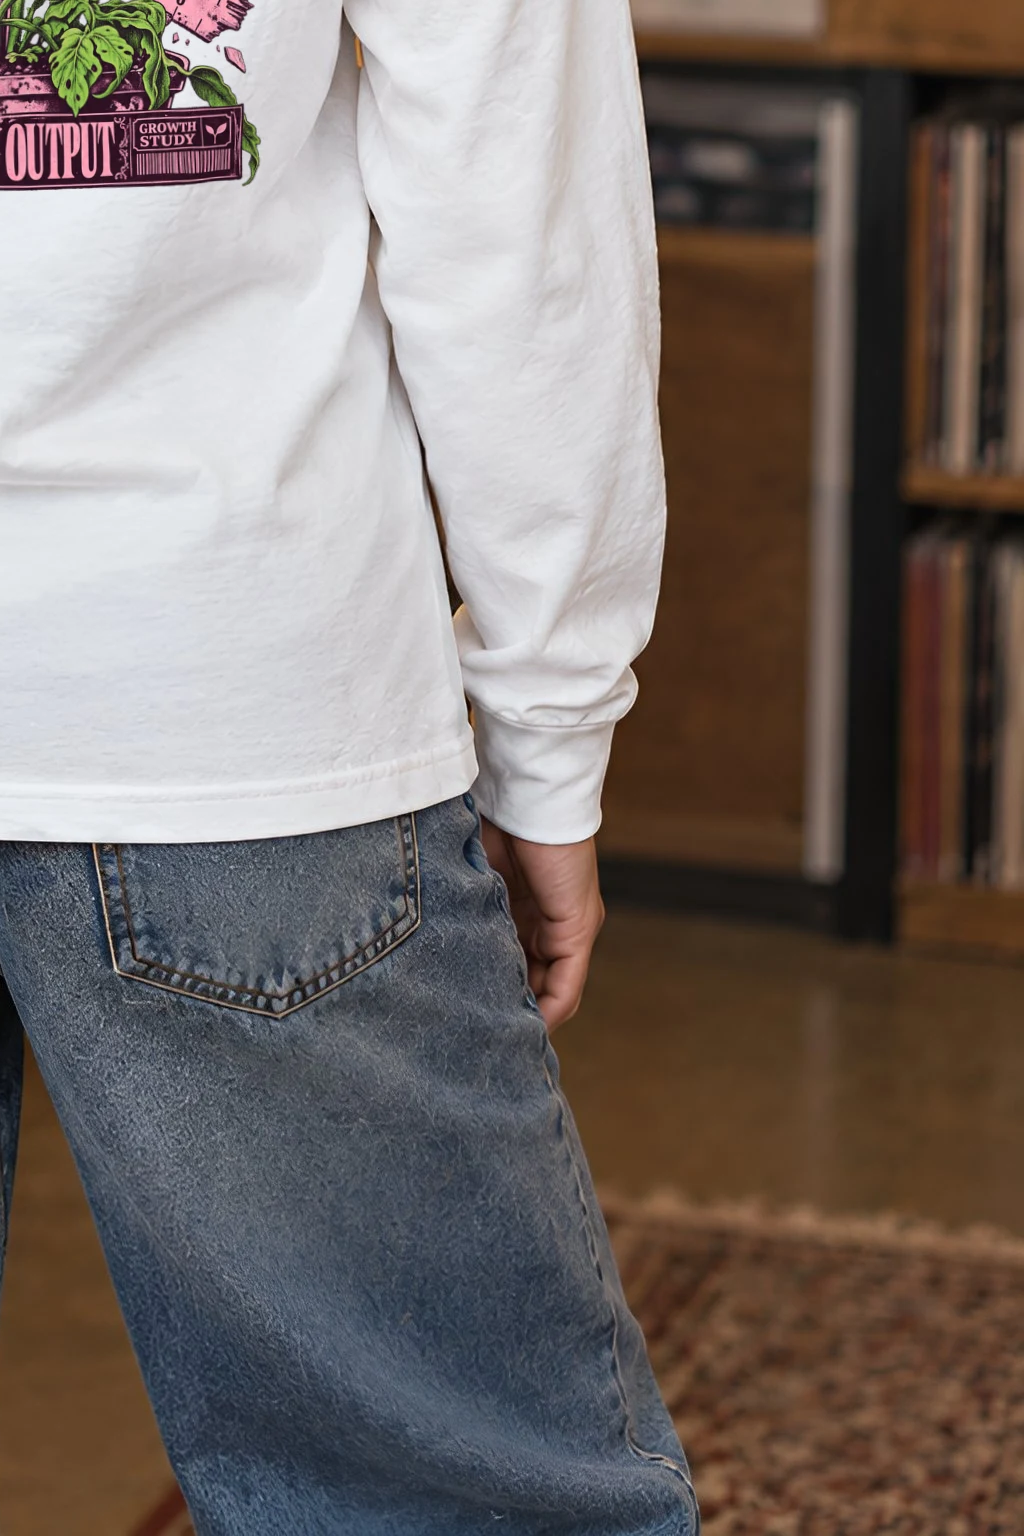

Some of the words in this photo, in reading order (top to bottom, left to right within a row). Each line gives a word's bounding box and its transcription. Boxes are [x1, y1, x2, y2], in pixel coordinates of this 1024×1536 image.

[138, 121, 197, 134] GROWTH
[139, 133, 196, 148] STUDY
[5, 121, 116, 182] OUTPUT
